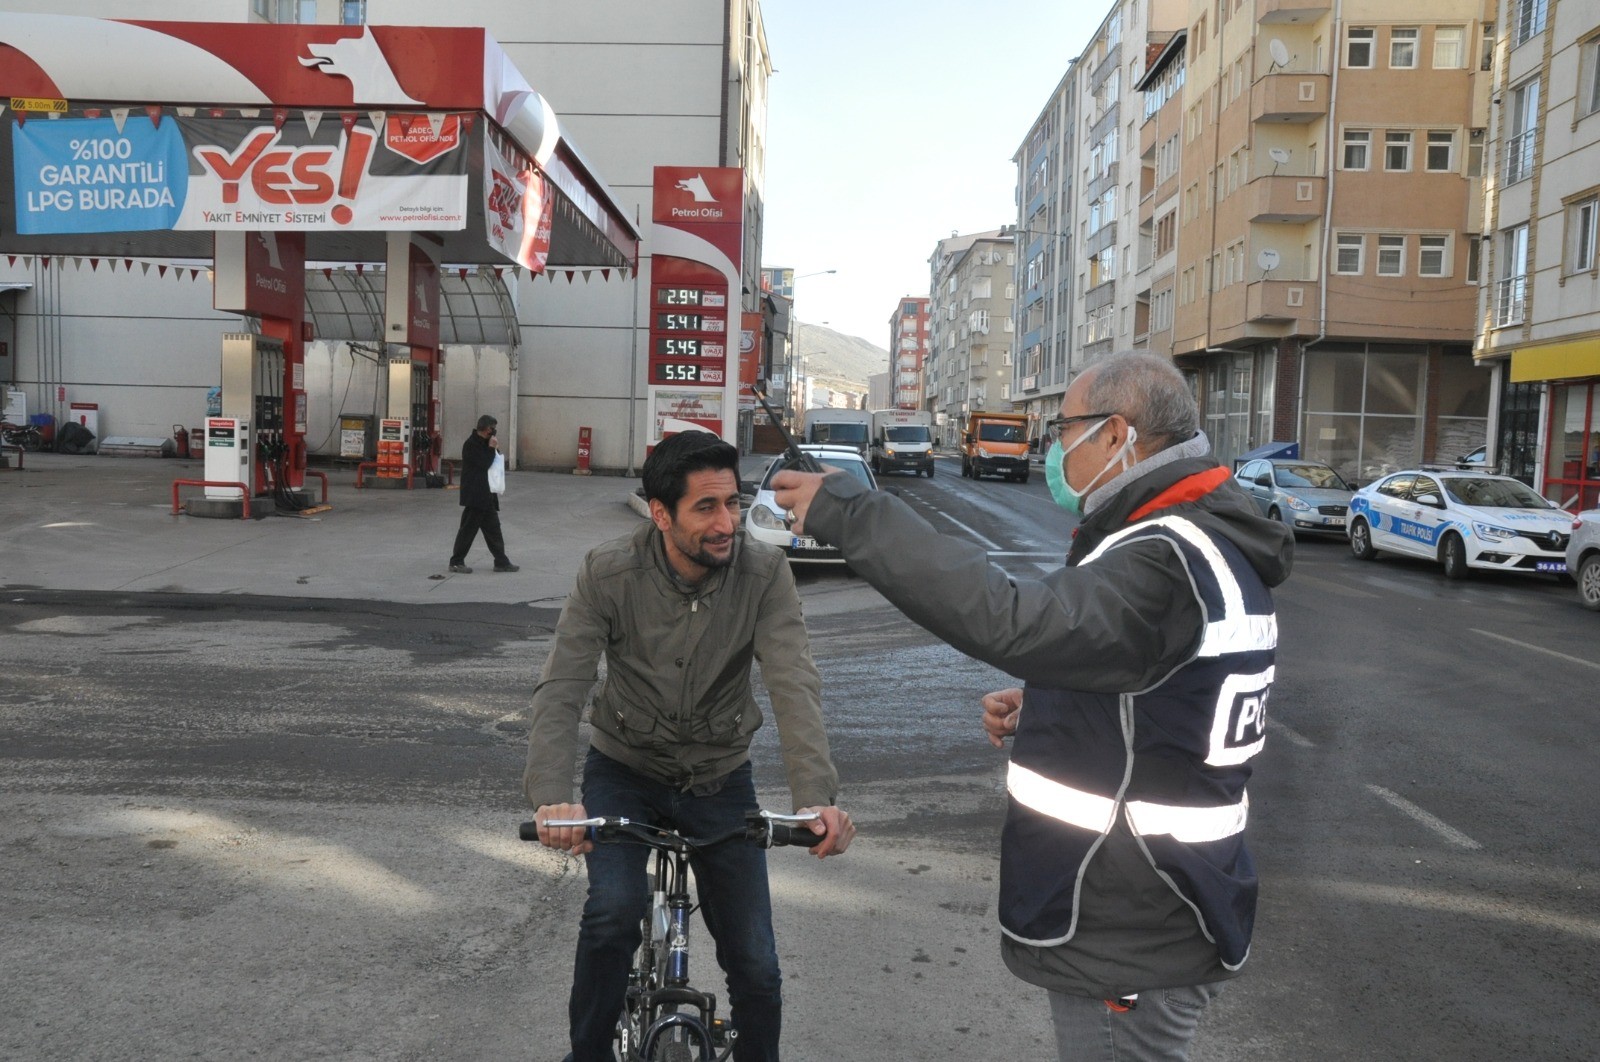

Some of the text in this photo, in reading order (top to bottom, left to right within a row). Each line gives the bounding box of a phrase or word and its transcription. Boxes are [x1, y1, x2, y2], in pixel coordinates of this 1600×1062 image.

[69, 138, 131, 160] %100
[40, 161, 163, 186] GARANTİLİ
[194, 128, 376, 226] YES!
[28, 187, 175, 212] LPG BURADA
[203, 211, 326, 223] YAKIT EMNİYET SİSTEMİ
[672, 207, 723, 217] Petrol Ofisi
[255, 272, 273, 289] Petrol
[667, 289, 698, 304] 2.94
[667, 315, 697, 330] 5.41
[666, 340, 697, 355] 5.45
[665, 365, 696, 380] 5.52
[1401, 522, 1433, 541] TRAFİK POLİSİ
[1234, 687, 1269, 742] PO
